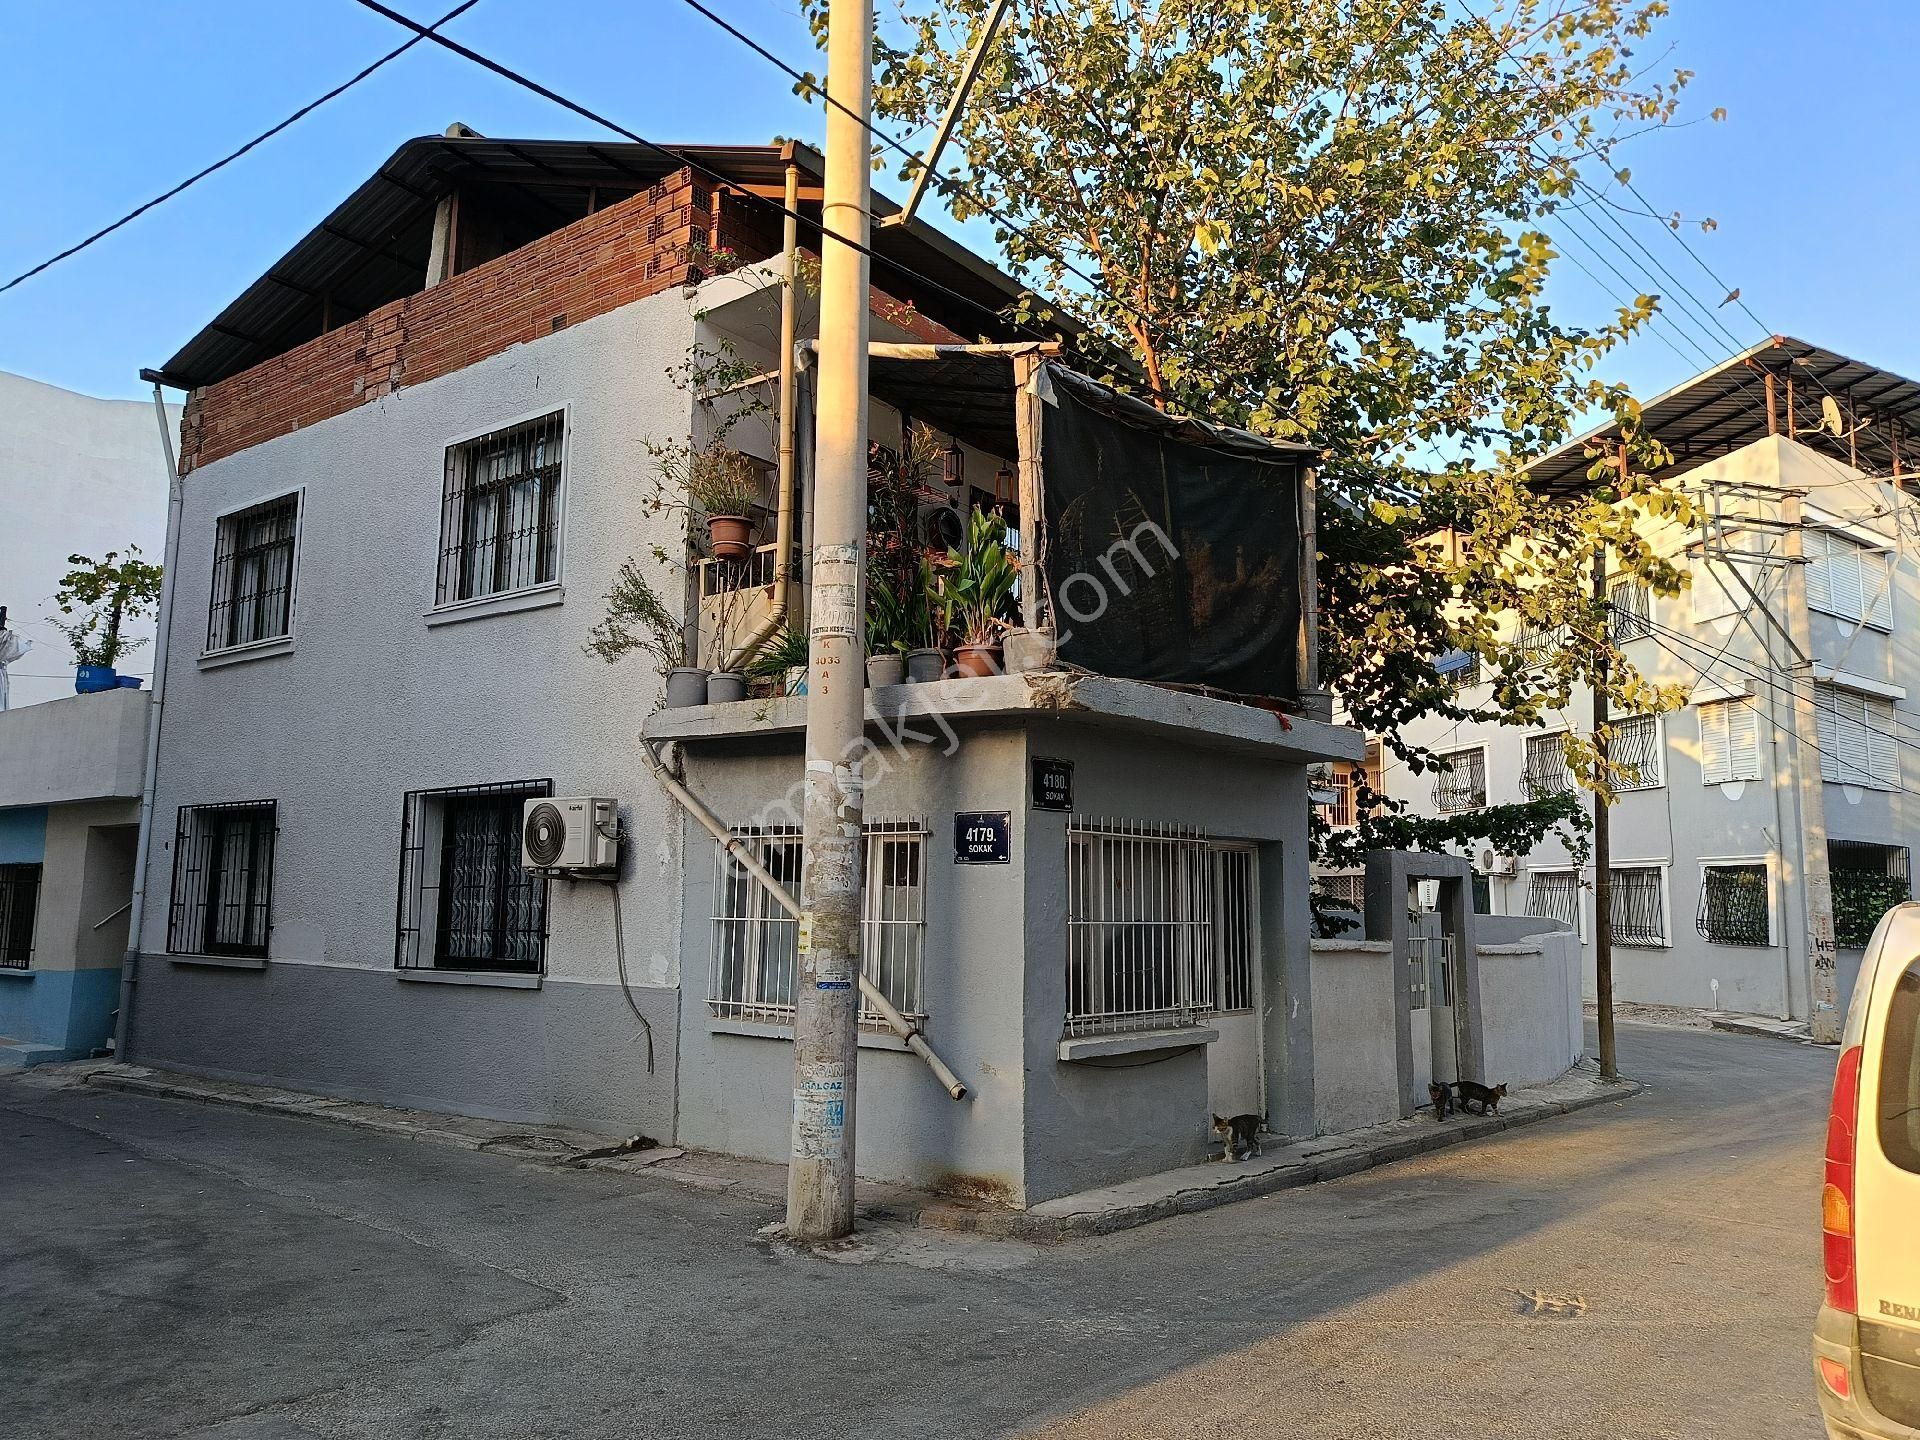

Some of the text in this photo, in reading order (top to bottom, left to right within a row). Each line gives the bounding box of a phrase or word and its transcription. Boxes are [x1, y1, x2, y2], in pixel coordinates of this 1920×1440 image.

[823, 641, 830, 649] K
[821, 670, 830, 679] A
[822, 685, 829, 695] 3
[1043, 773, 1068, 790] 4180.
[1045, 791, 1065, 801] SOKAK
[965, 827, 997, 842] 4179.
[968, 844, 993, 853] SOKAK
[1879, 1299, 1920, 1322] REN
